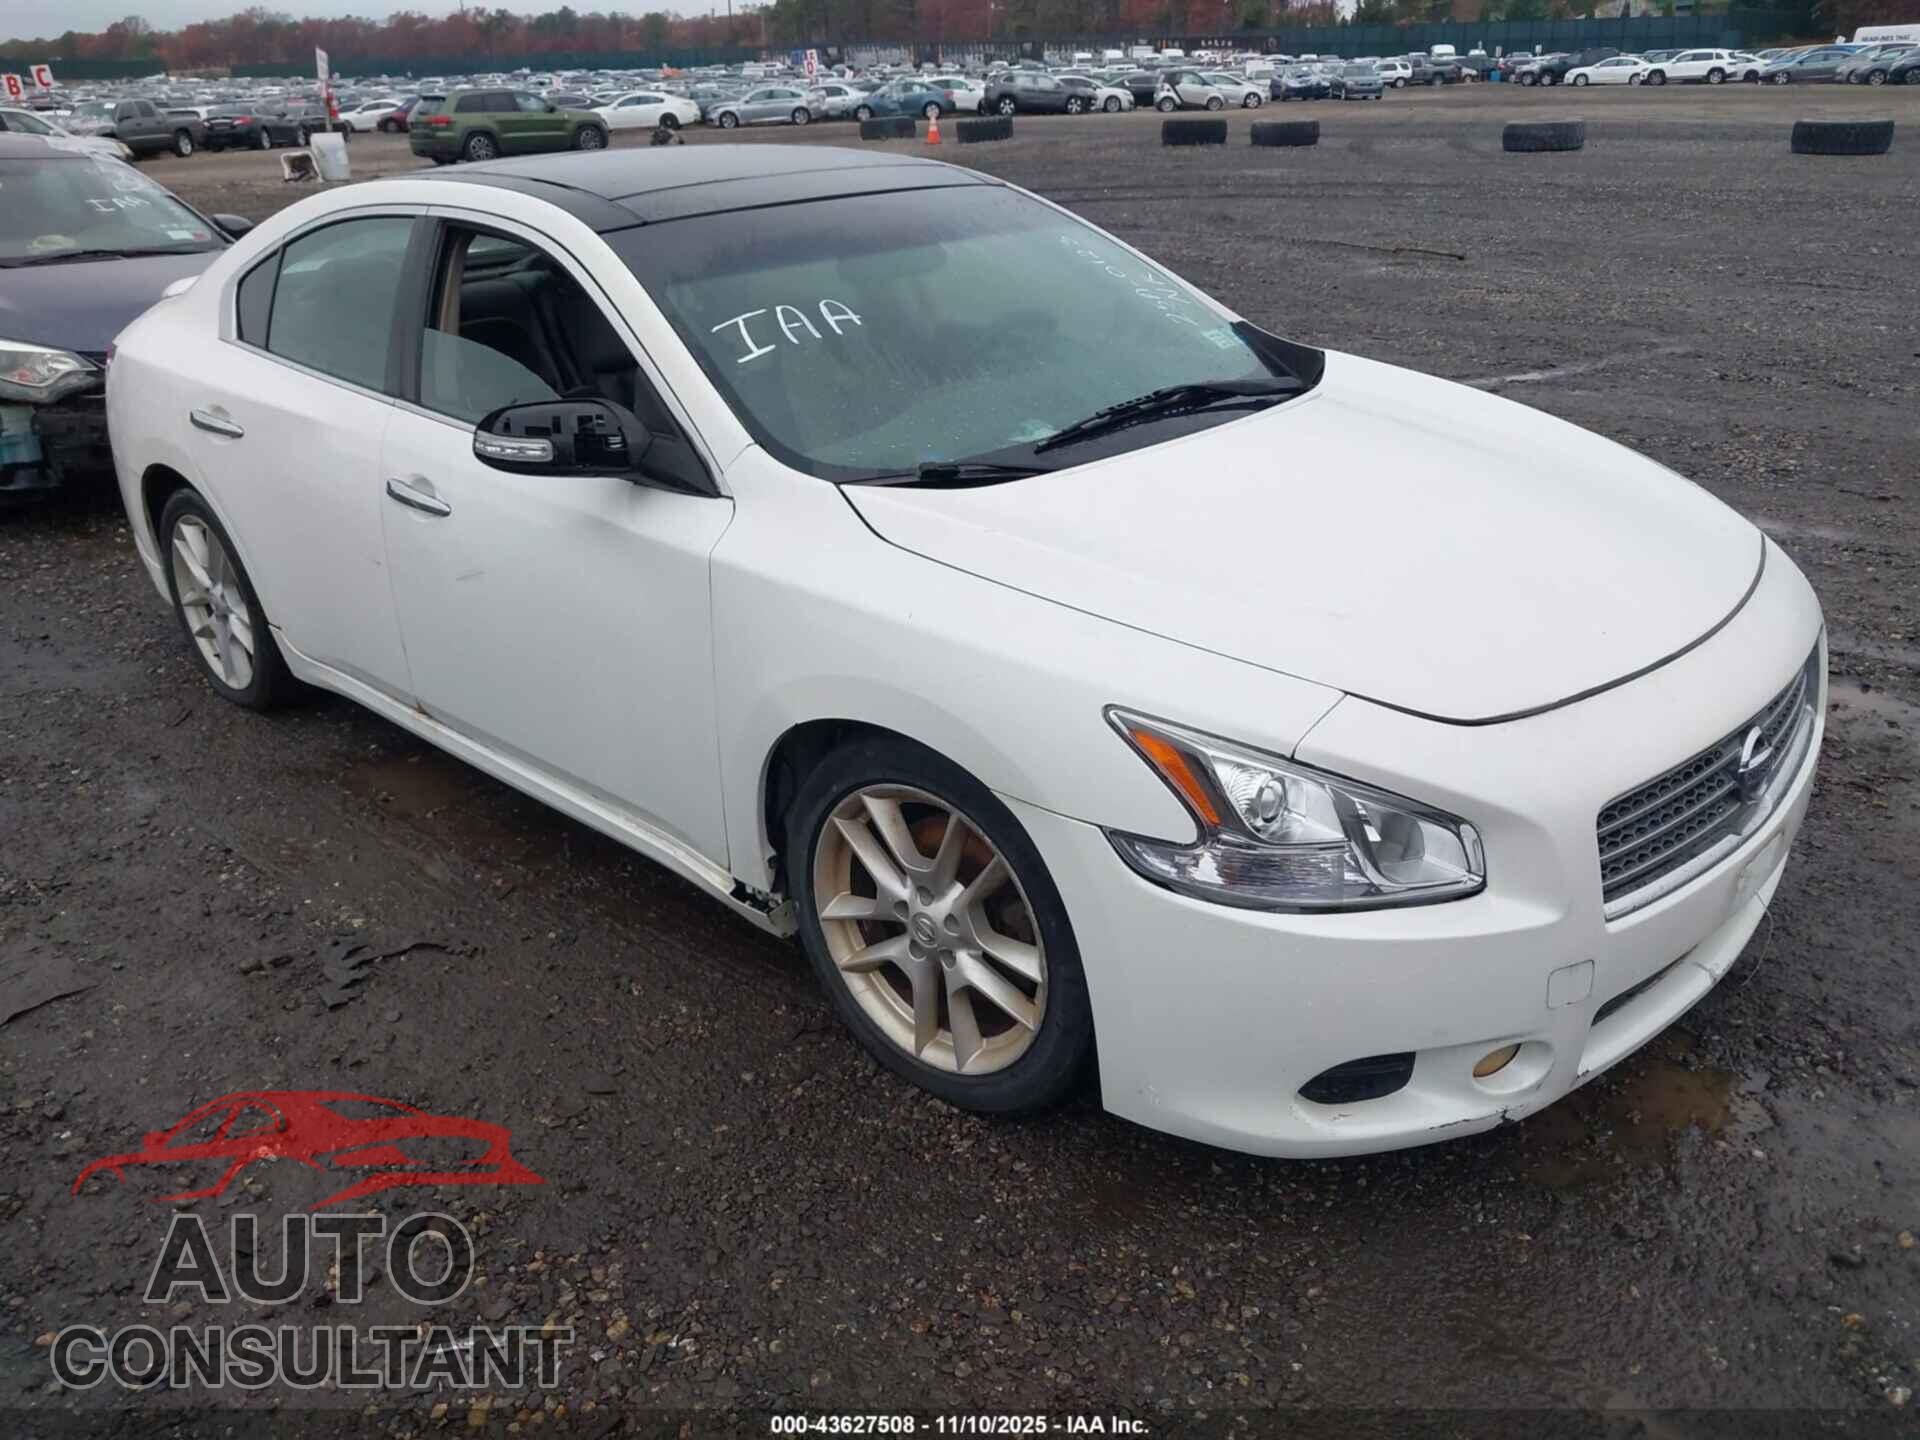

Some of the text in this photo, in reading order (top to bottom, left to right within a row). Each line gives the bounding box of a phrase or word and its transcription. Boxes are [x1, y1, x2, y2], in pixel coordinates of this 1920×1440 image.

[6, 76, 21, 96] B
[36, 67, 51, 87] C
[711, 299, 862, 363] IAA
